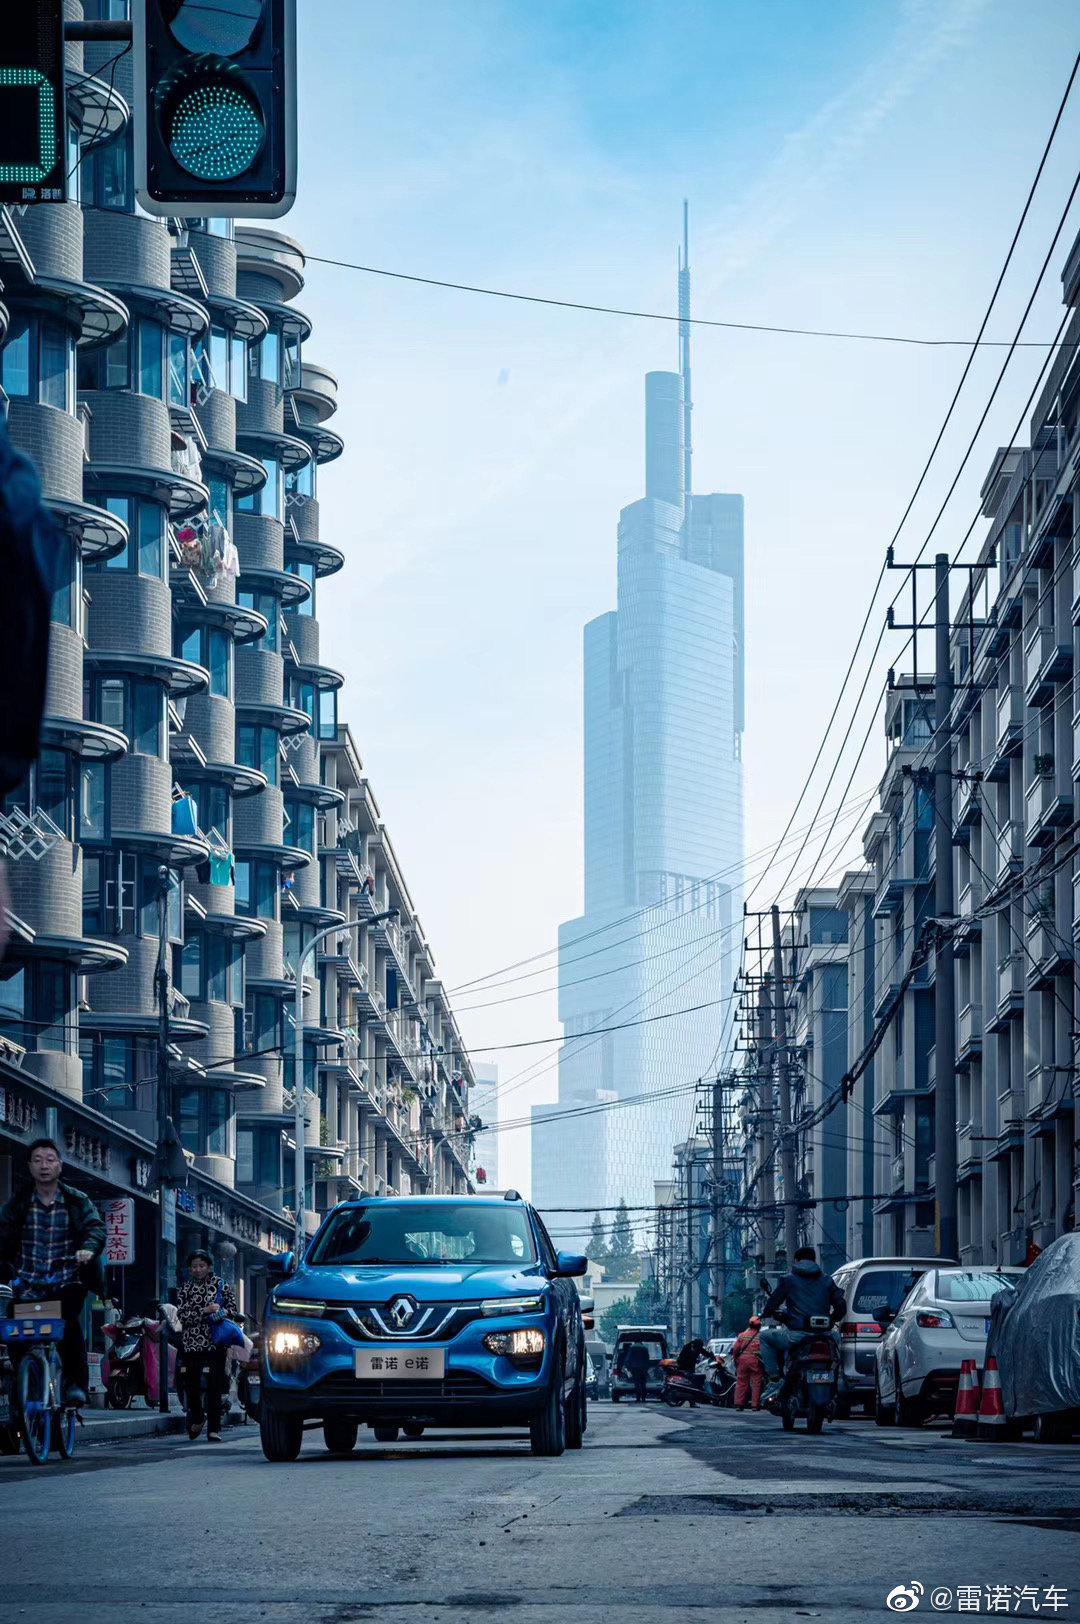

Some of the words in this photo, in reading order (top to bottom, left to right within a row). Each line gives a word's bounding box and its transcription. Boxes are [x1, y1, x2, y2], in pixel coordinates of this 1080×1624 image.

[105, 1201, 128, 1260] 乡村土菜馆
[370, 1357, 398, 1370] 雷诺
[405, 1357, 429, 1370] e诺
